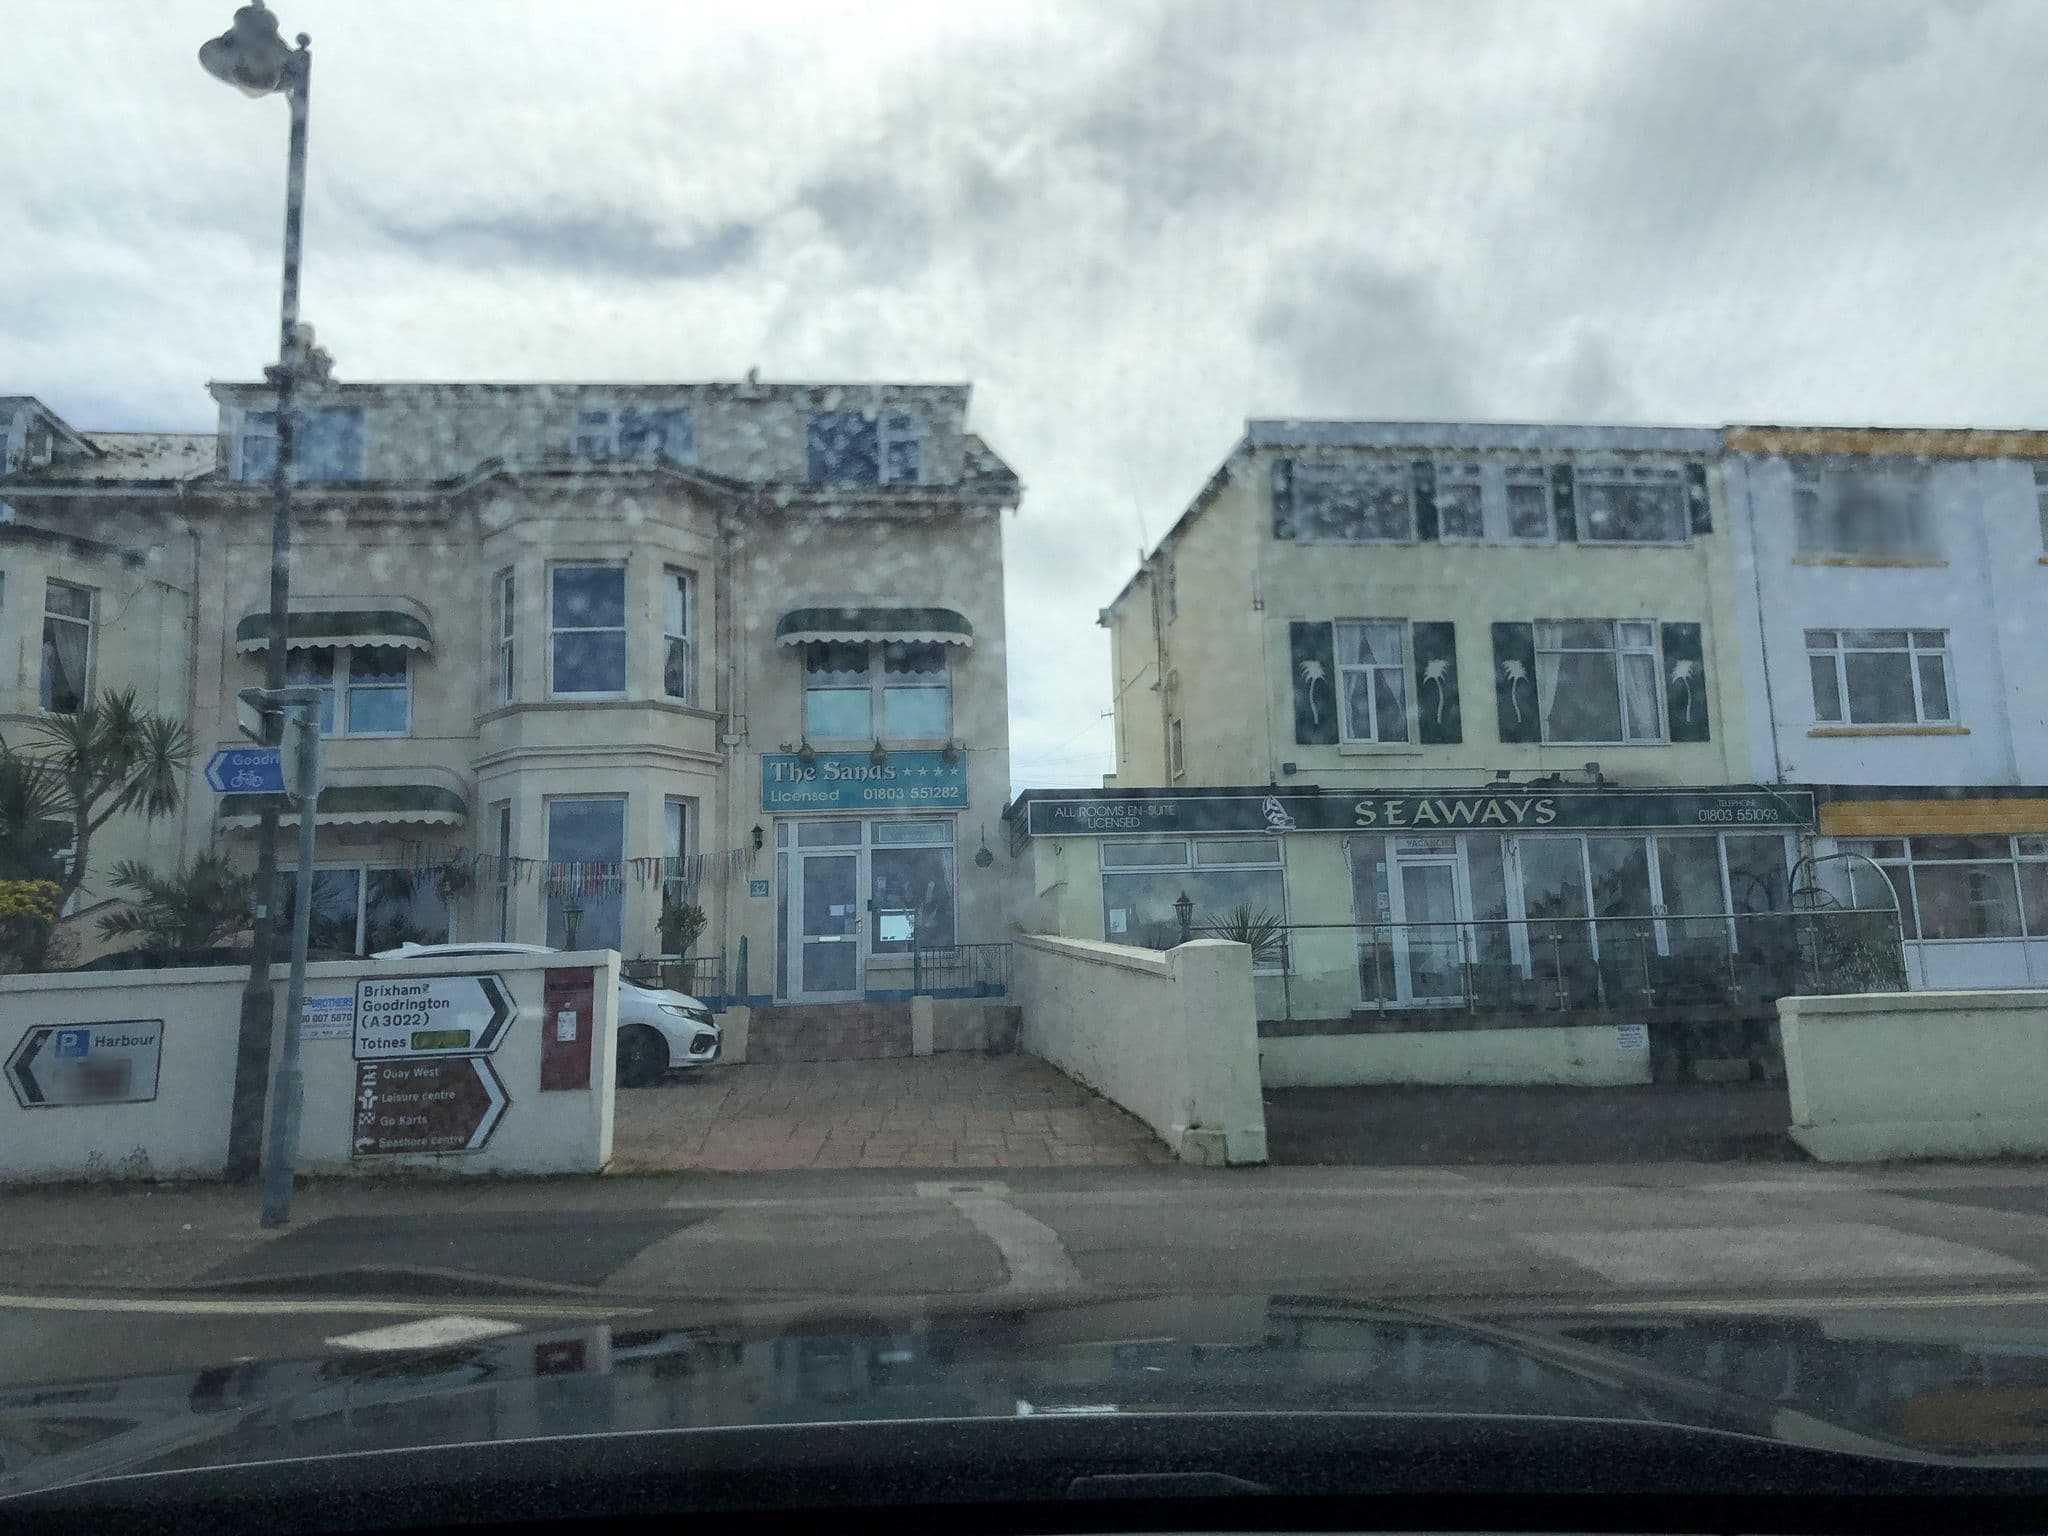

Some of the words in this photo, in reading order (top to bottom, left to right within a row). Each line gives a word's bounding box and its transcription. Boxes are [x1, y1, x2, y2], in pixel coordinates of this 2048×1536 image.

[769, 762, 817, 784] The
[824, 761, 896, 782] Sands
[771, 790, 840, 802] Licensed
[864, 787, 904, 800] 01803
[911, 786, 959, 799] 551282
[1054, 806, 1074, 818] ALL
[1079, 805, 1124, 817] ROOMS
[1354, 799, 1557, 825] SEAWAYS
[1698, 809, 1733, 821] 01803
[1737, 808, 1779, 821] 551093
[1087, 817, 1141, 829] LICENSED
[364, 985, 421, 997] Brixham
[363, 999, 450, 1014] Goodrington
[94, 1035, 155, 1047] Harbour
[360, 1037, 407, 1049] Totnes
[383, 1069, 410, 1079] Quay
[413, 1067, 440, 1077] West
[382, 1093, 419, 1103] Leisure
[422, 1091, 456, 1100] centre
[380, 1116, 396, 1126] Go
[399, 1115, 427, 1125] Karts
